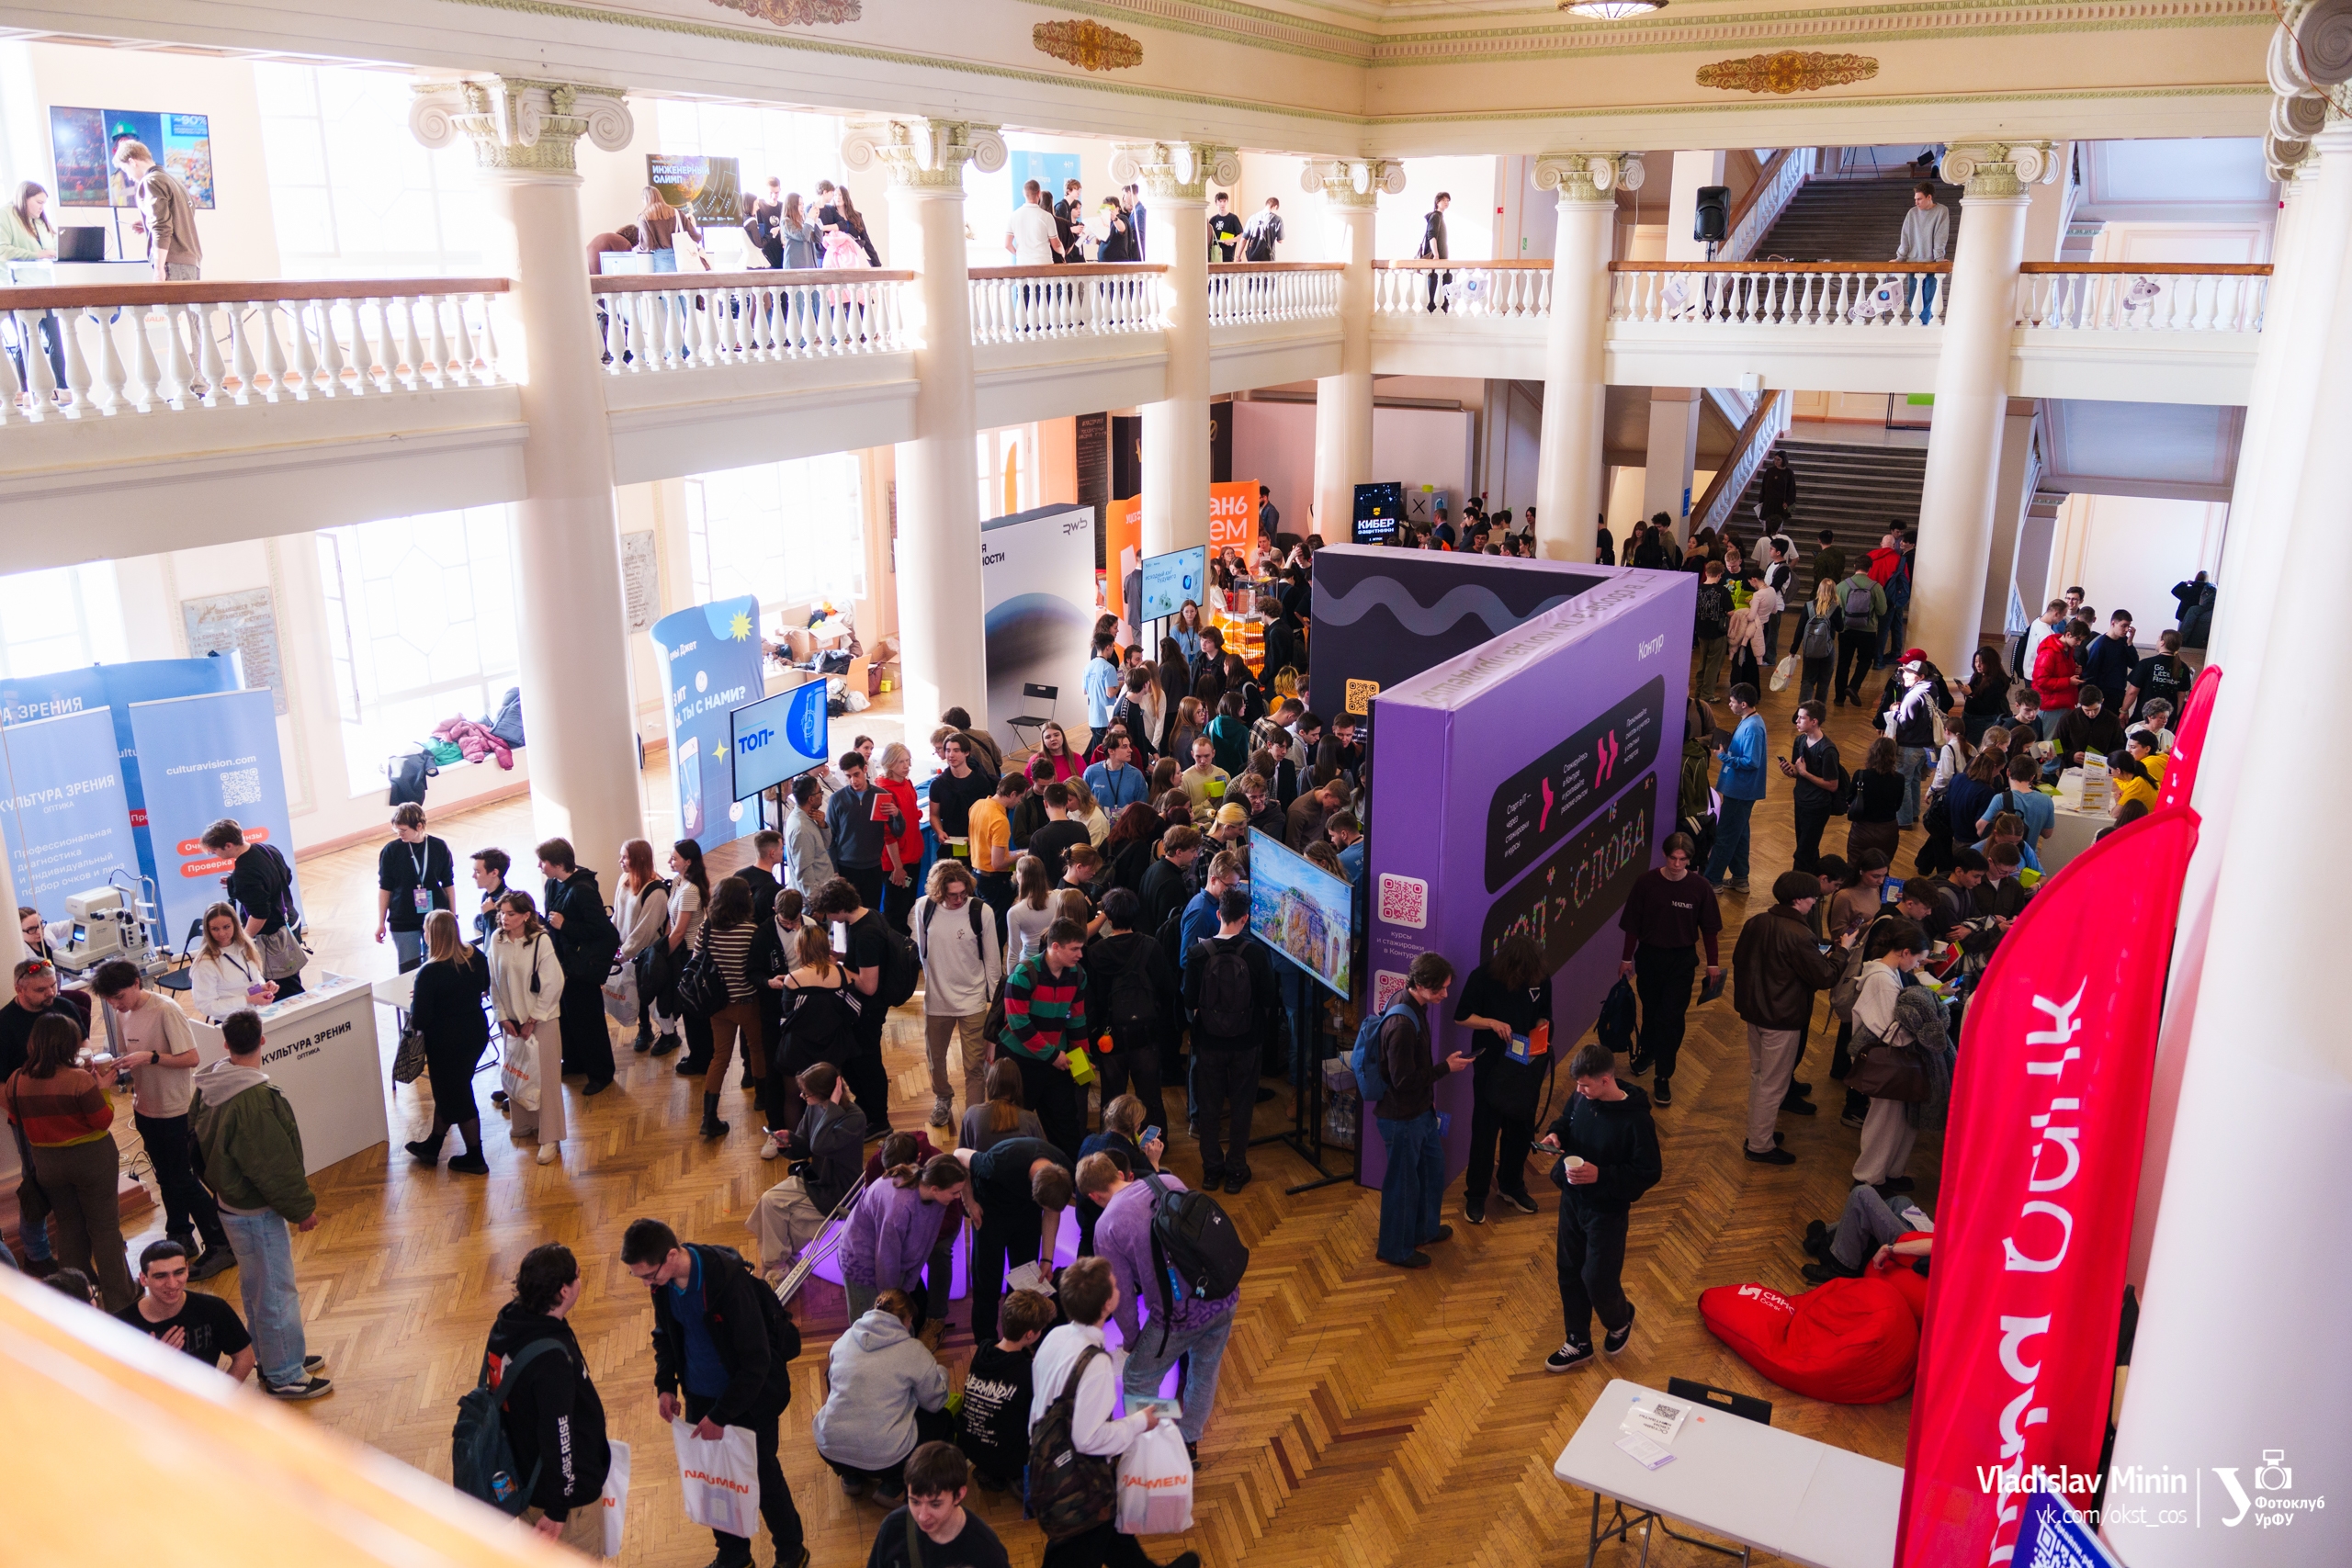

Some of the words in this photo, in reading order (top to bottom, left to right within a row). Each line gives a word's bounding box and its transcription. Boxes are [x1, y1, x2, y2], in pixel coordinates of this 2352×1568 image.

[652, 165, 709, 175] ИНЖЕНЕРНЫЙ
[653, 175, 683, 184] ОЛИМП
[1358, 518, 1396, 530] КИБЕР
[1554, 619, 1584, 631] ты
[680, 640, 697, 658] Джет
[1510, 629, 1560, 656] когда
[1638, 634, 1665, 661] Контур
[17, 696, 84, 719] ЗРЕНИЯ
[695, 701, 703, 715] С
[704, 685, 746, 711] НАМИ?
[739, 728, 775, 754] ТОП-
[166, 755, 257, 775] culturavision.com
[66, 774, 115, 796] ЗРЕНИЯ
[43, 800, 75, 815] ОПТИКА
[1507, 801, 1519, 815] Старт
[14, 828, 112, 860] Профессиональная
[17, 849, 83, 873] диагностика
[30, 852, 114, 882] индивидуальный
[187, 858, 232, 873] Проверка
[21, 880, 60, 897] подбор
[62, 873, 91, 886] очков
[1382, 939, 1425, 952] стажировки
[1391, 931, 1412, 941] курсы
[1389, 948, 1418, 959] Контуре
[261, 1038, 312, 1066] КУЛЬТУРА
[314, 1021, 352, 1044] ЗРЕНИЯ
[296, 1046, 321, 1061] ОПТИКА
[558, 1415, 571, 1454] REISE
[684, 1469, 749, 1495] NAUMEN
